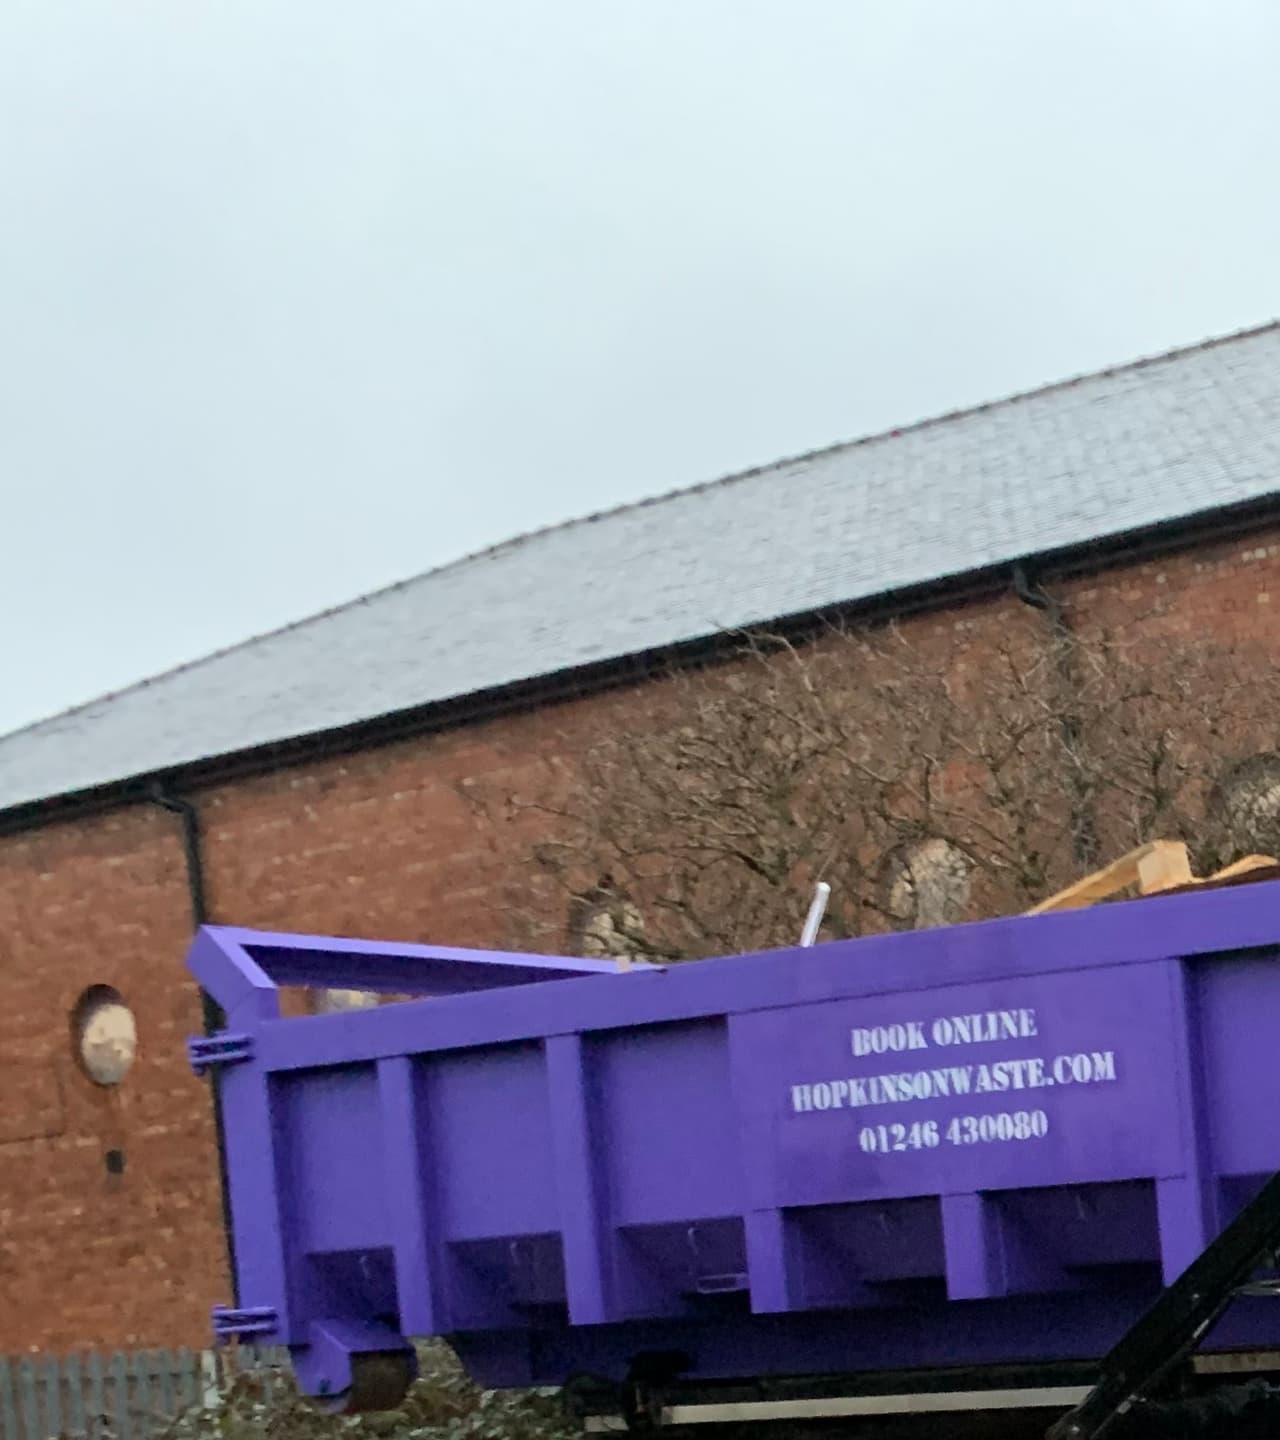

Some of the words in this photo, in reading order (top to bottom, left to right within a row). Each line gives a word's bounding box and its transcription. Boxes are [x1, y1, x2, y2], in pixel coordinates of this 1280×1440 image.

[851, 1021, 928, 1057] BOOK
[932, 1008, 1038, 1047] ONLINE
[790, 1051, 1117, 1113] HOPKINSONWASTE.COM
[858, 1119, 940, 1153] 01246
[945, 1109, 1049, 1145] 430080
